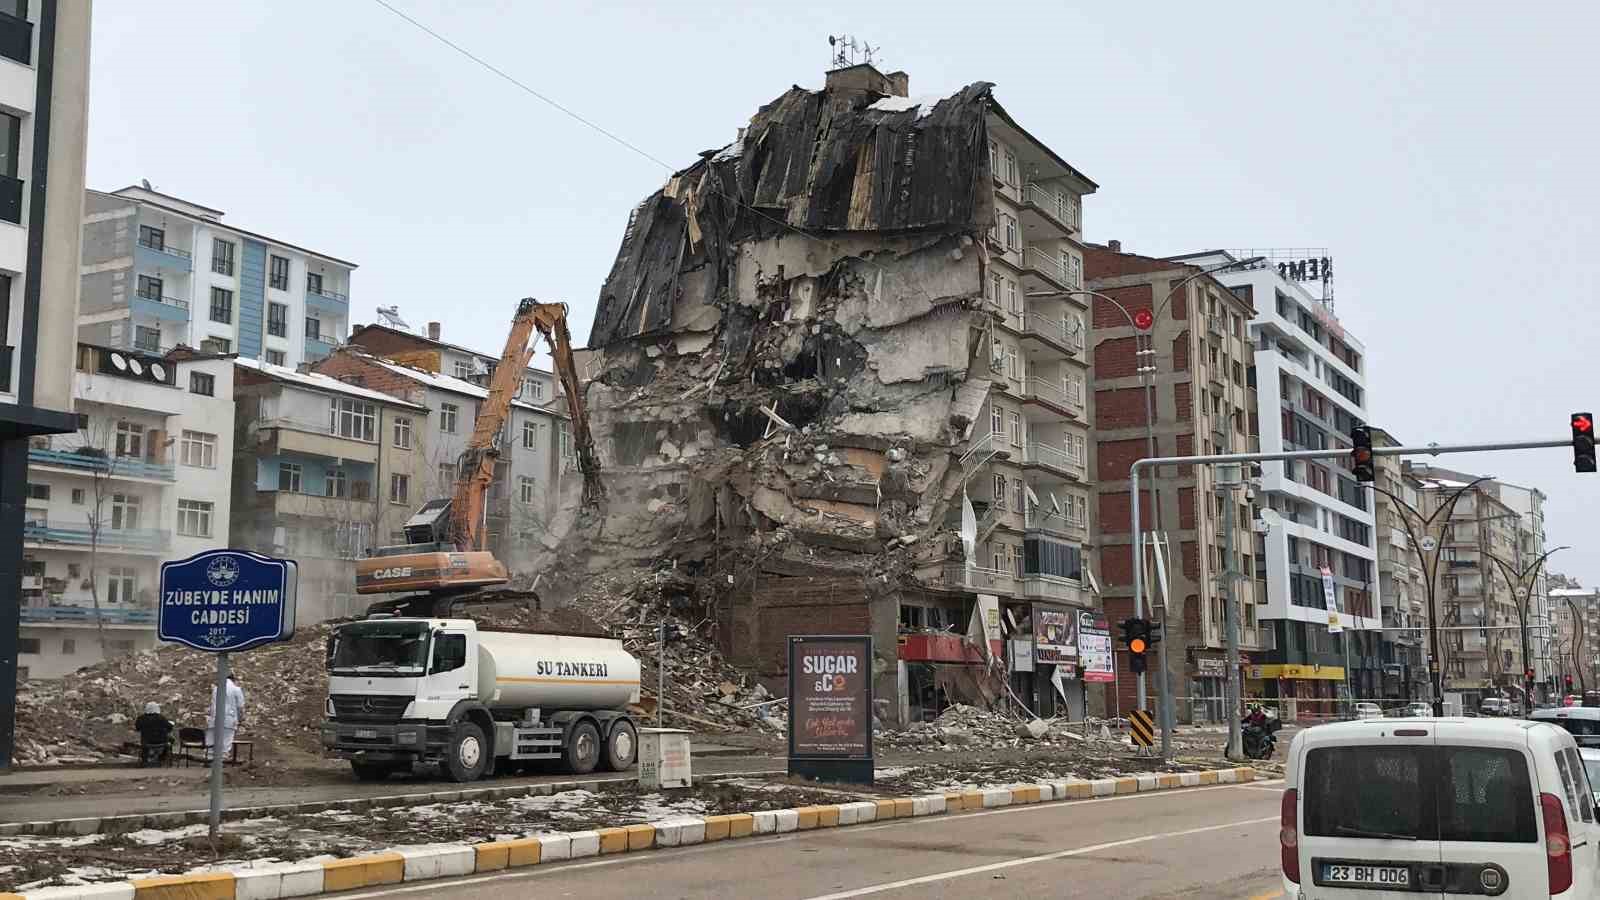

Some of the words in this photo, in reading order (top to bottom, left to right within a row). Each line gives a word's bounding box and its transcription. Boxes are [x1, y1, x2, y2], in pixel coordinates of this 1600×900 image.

[374, 567, 412, 579] CASE
[165, 588, 229, 606] ZÜBEYDE
[232, 589, 279, 605] HANIM
[191, 607, 249, 624] CADDESİ
[208, 627, 227, 635] 2017
[537, 660, 553, 676] SU
[803, 655, 857, 674] SUGAR
[1331, 867, 1350, 881] 23
[1354, 867, 1375, 882] BH
[1379, 869, 1407, 883] 006
